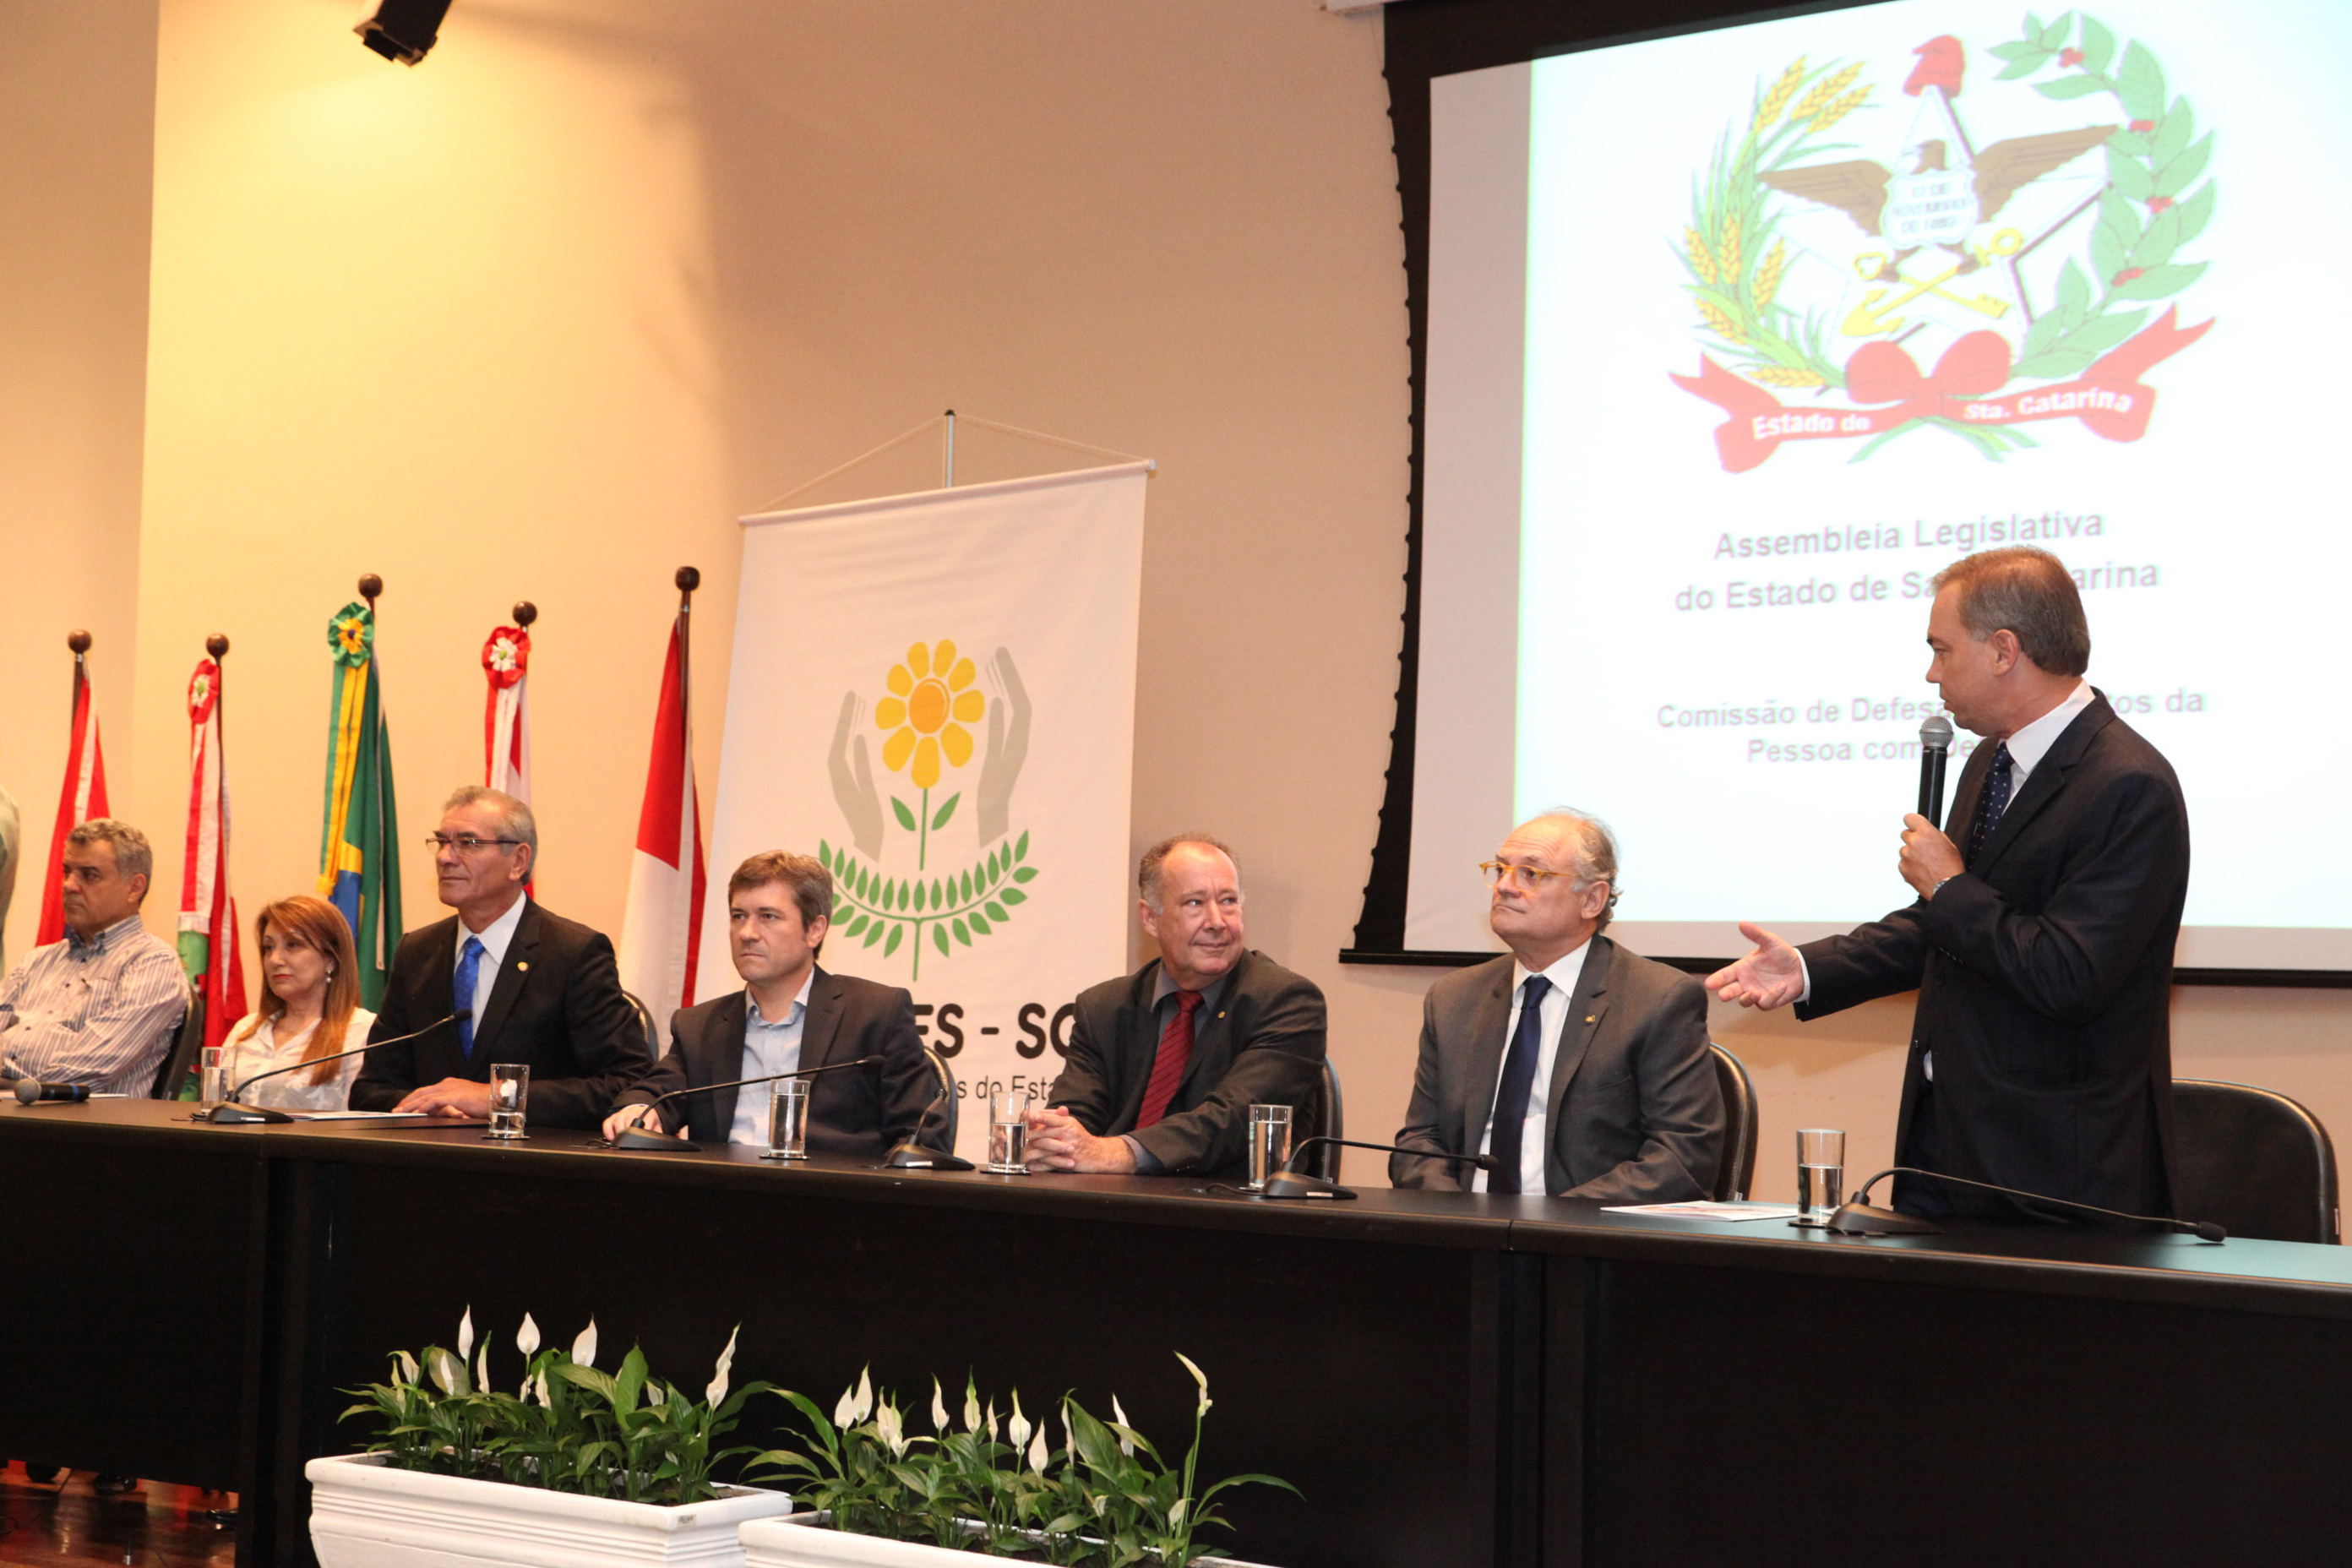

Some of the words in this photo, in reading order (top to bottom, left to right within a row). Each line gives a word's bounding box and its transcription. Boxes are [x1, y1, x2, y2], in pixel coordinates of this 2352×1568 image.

[1963, 404, 2012, 419] Sta.
[2017, 387, 2133, 415] Catarina
[1752, 413, 1835, 440] Estado
[1841, 414, 1871, 432] de
[1714, 523, 1901, 559] Assembleia
[1915, 511, 2104, 552] Legislativa
[1674, 585, 1714, 611] do
[1726, 577, 1838, 608] Estado
[1849, 574, 1888, 602] de
[2074, 561, 2159, 590] arina
[1657, 700, 1796, 728] Comissão
[1805, 700, 1840, 723] de
[2164, 687, 2204, 712] da
[1748, 739, 1853, 762] Pessoa
[1864, 741, 1923, 760] com
